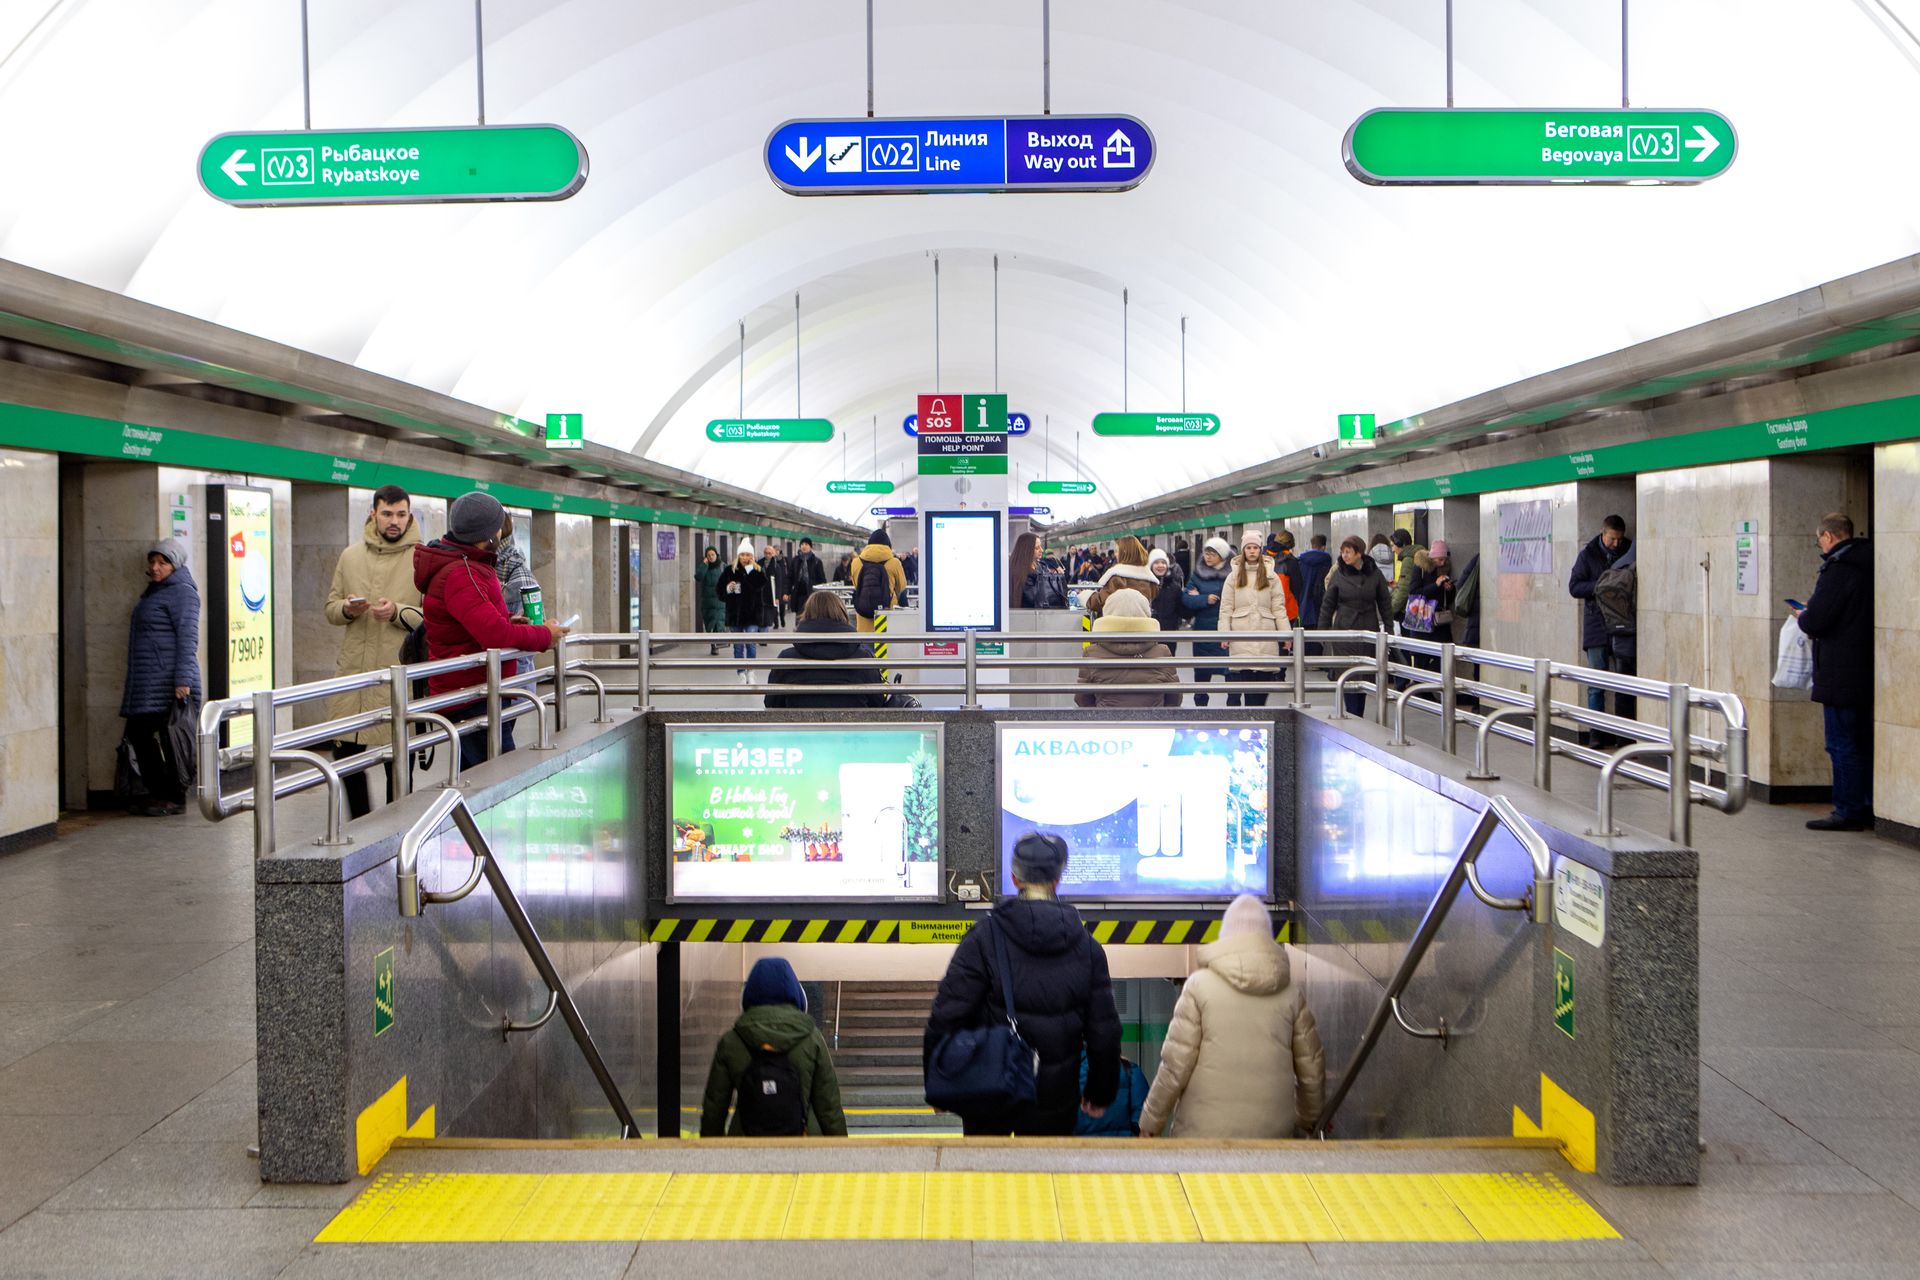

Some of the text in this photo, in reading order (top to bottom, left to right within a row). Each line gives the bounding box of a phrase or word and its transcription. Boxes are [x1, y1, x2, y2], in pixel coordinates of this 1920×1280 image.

[1545, 121, 1623, 138] Беговая
[924, 130, 988, 147] Линия
[1027, 131, 1094, 150] Выход
[321, 144, 420, 163] Рыбацкое
[1541, 147, 1623, 166] Begovaya
[925, 155, 961, 171] Line
[1023, 154, 1097, 173] Way out
[322, 166, 420, 187] Rybatskoye
[926, 417, 952, 428] SOS
[924, 435, 1002, 444] ПОМОЩЬ СПРАВКА
[942, 444, 985, 452] HELP POINT
[695, 742, 804, 768] ГЕЙЗЕР
[1014, 740, 1134, 756] АКВАФОР
[911, 921, 963, 931] Внимание!
